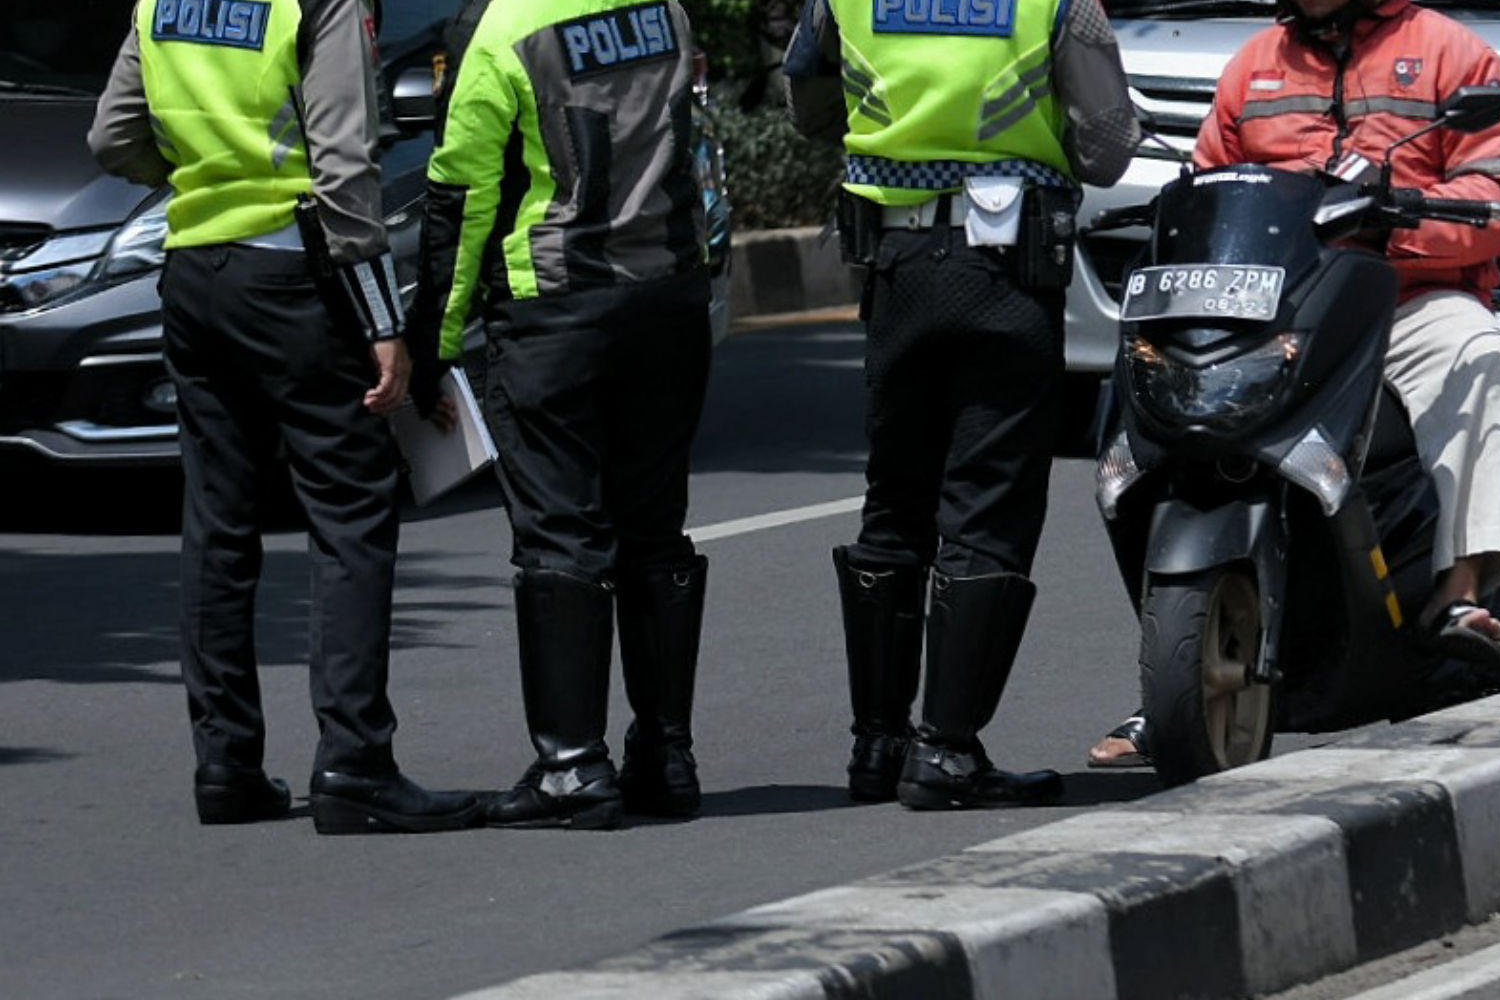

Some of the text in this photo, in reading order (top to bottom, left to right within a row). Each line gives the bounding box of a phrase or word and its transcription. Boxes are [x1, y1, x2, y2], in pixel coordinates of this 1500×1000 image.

[563, 6, 674, 72] POLISI
[1130, 269, 1278, 296] B 6286 ZPM
